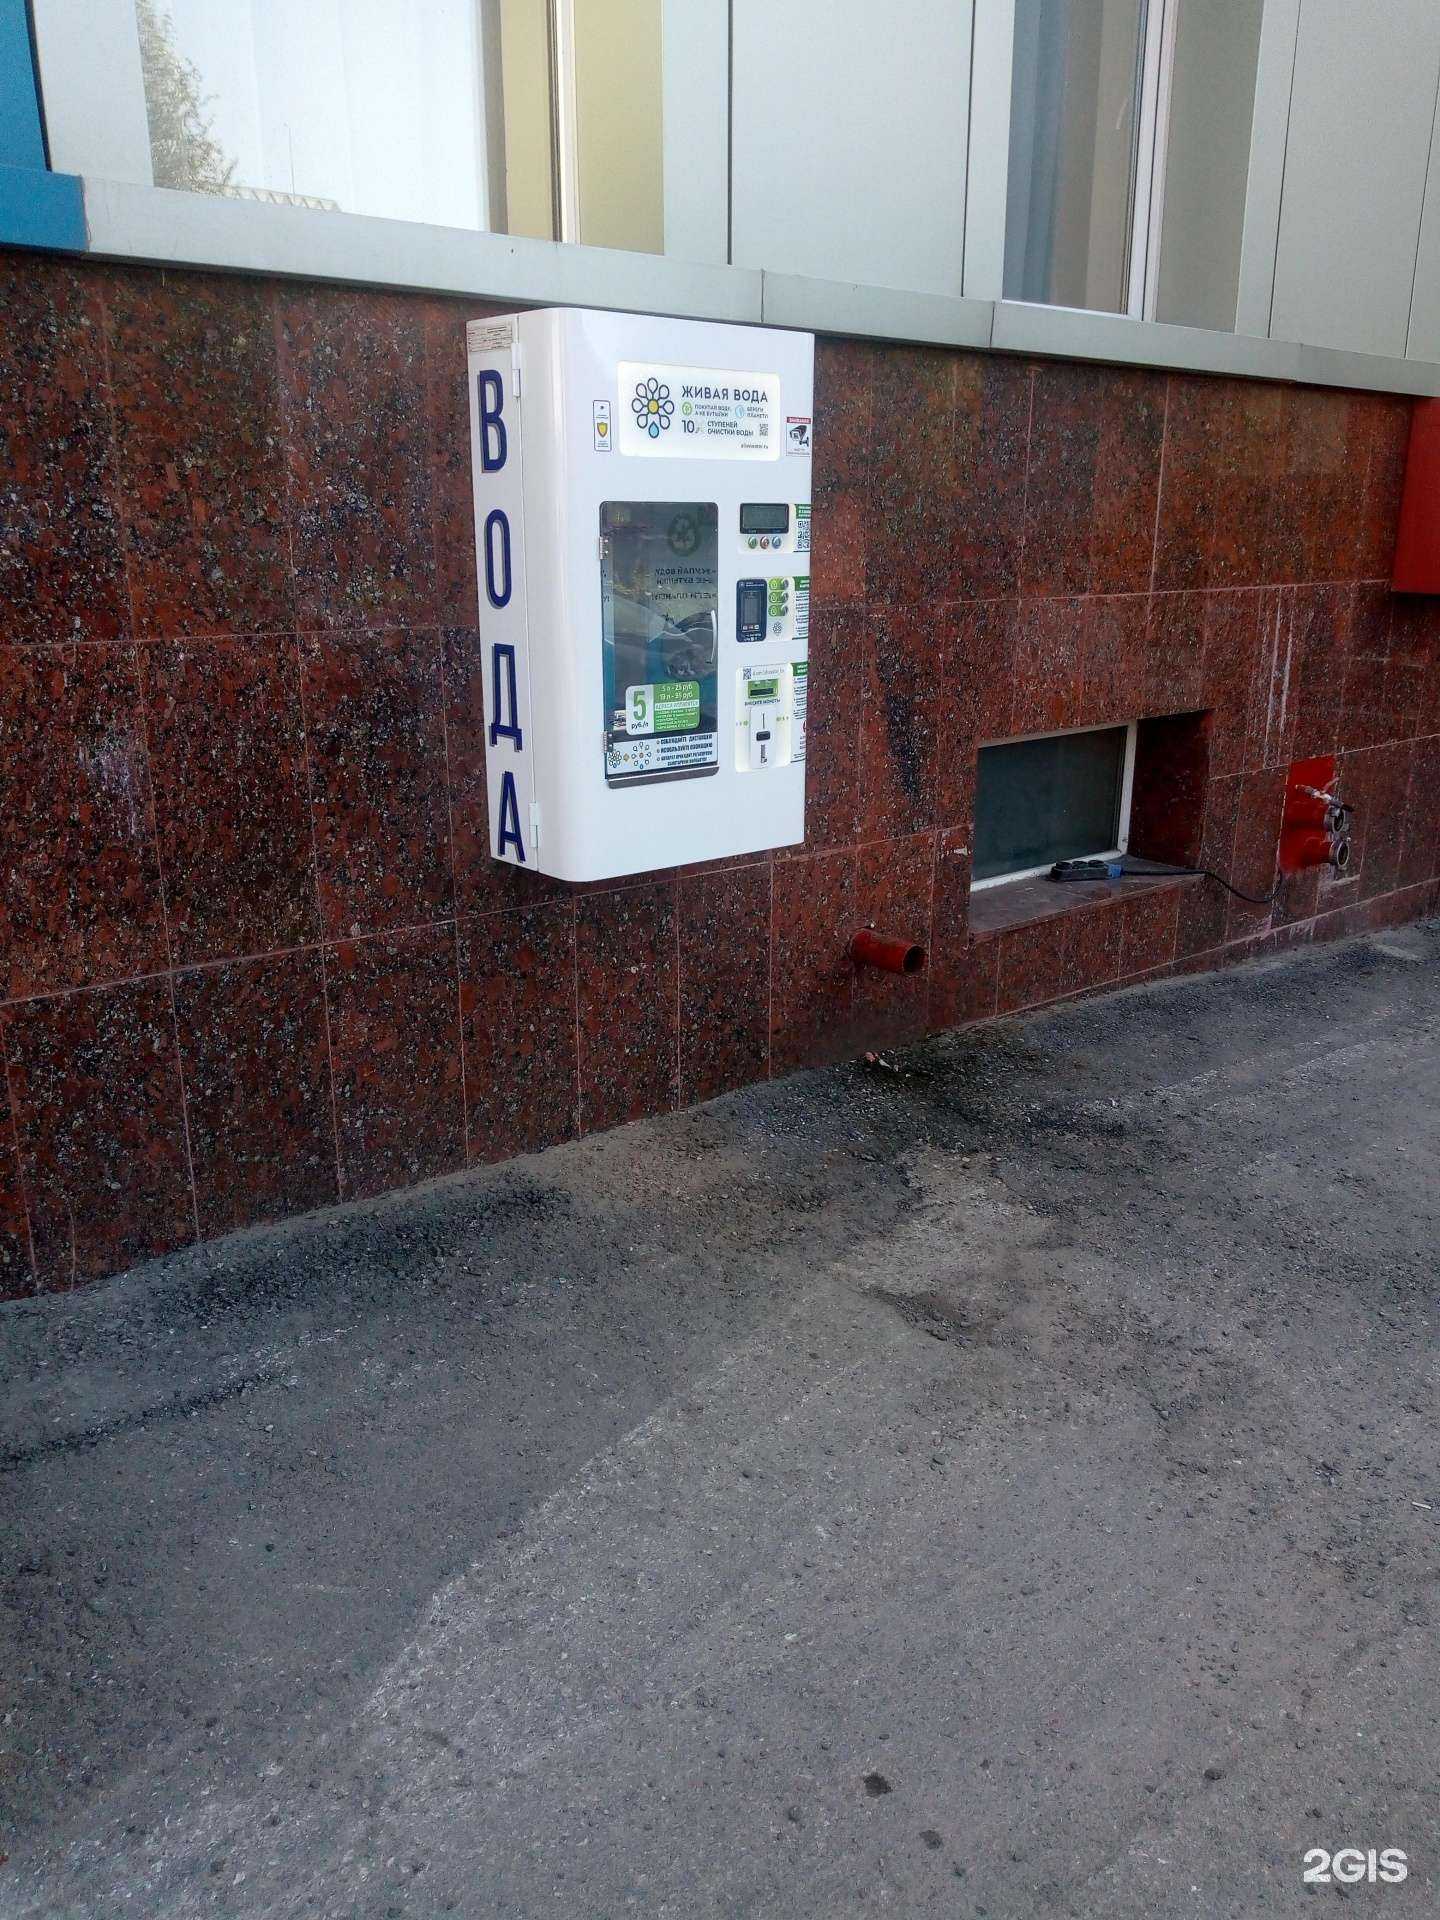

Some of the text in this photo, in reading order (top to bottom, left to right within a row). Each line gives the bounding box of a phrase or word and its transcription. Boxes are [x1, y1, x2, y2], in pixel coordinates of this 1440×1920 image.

[681, 385, 768, 404] ЖИВАЯ ВОДА
[707, 420, 738, 428] СТУПЕНЕЙ
[707, 428, 754, 437] ОЧИСТКИ ВОДЫ
[479, 368, 526, 864] ВОДА
[633, 690, 646, 720] 5
